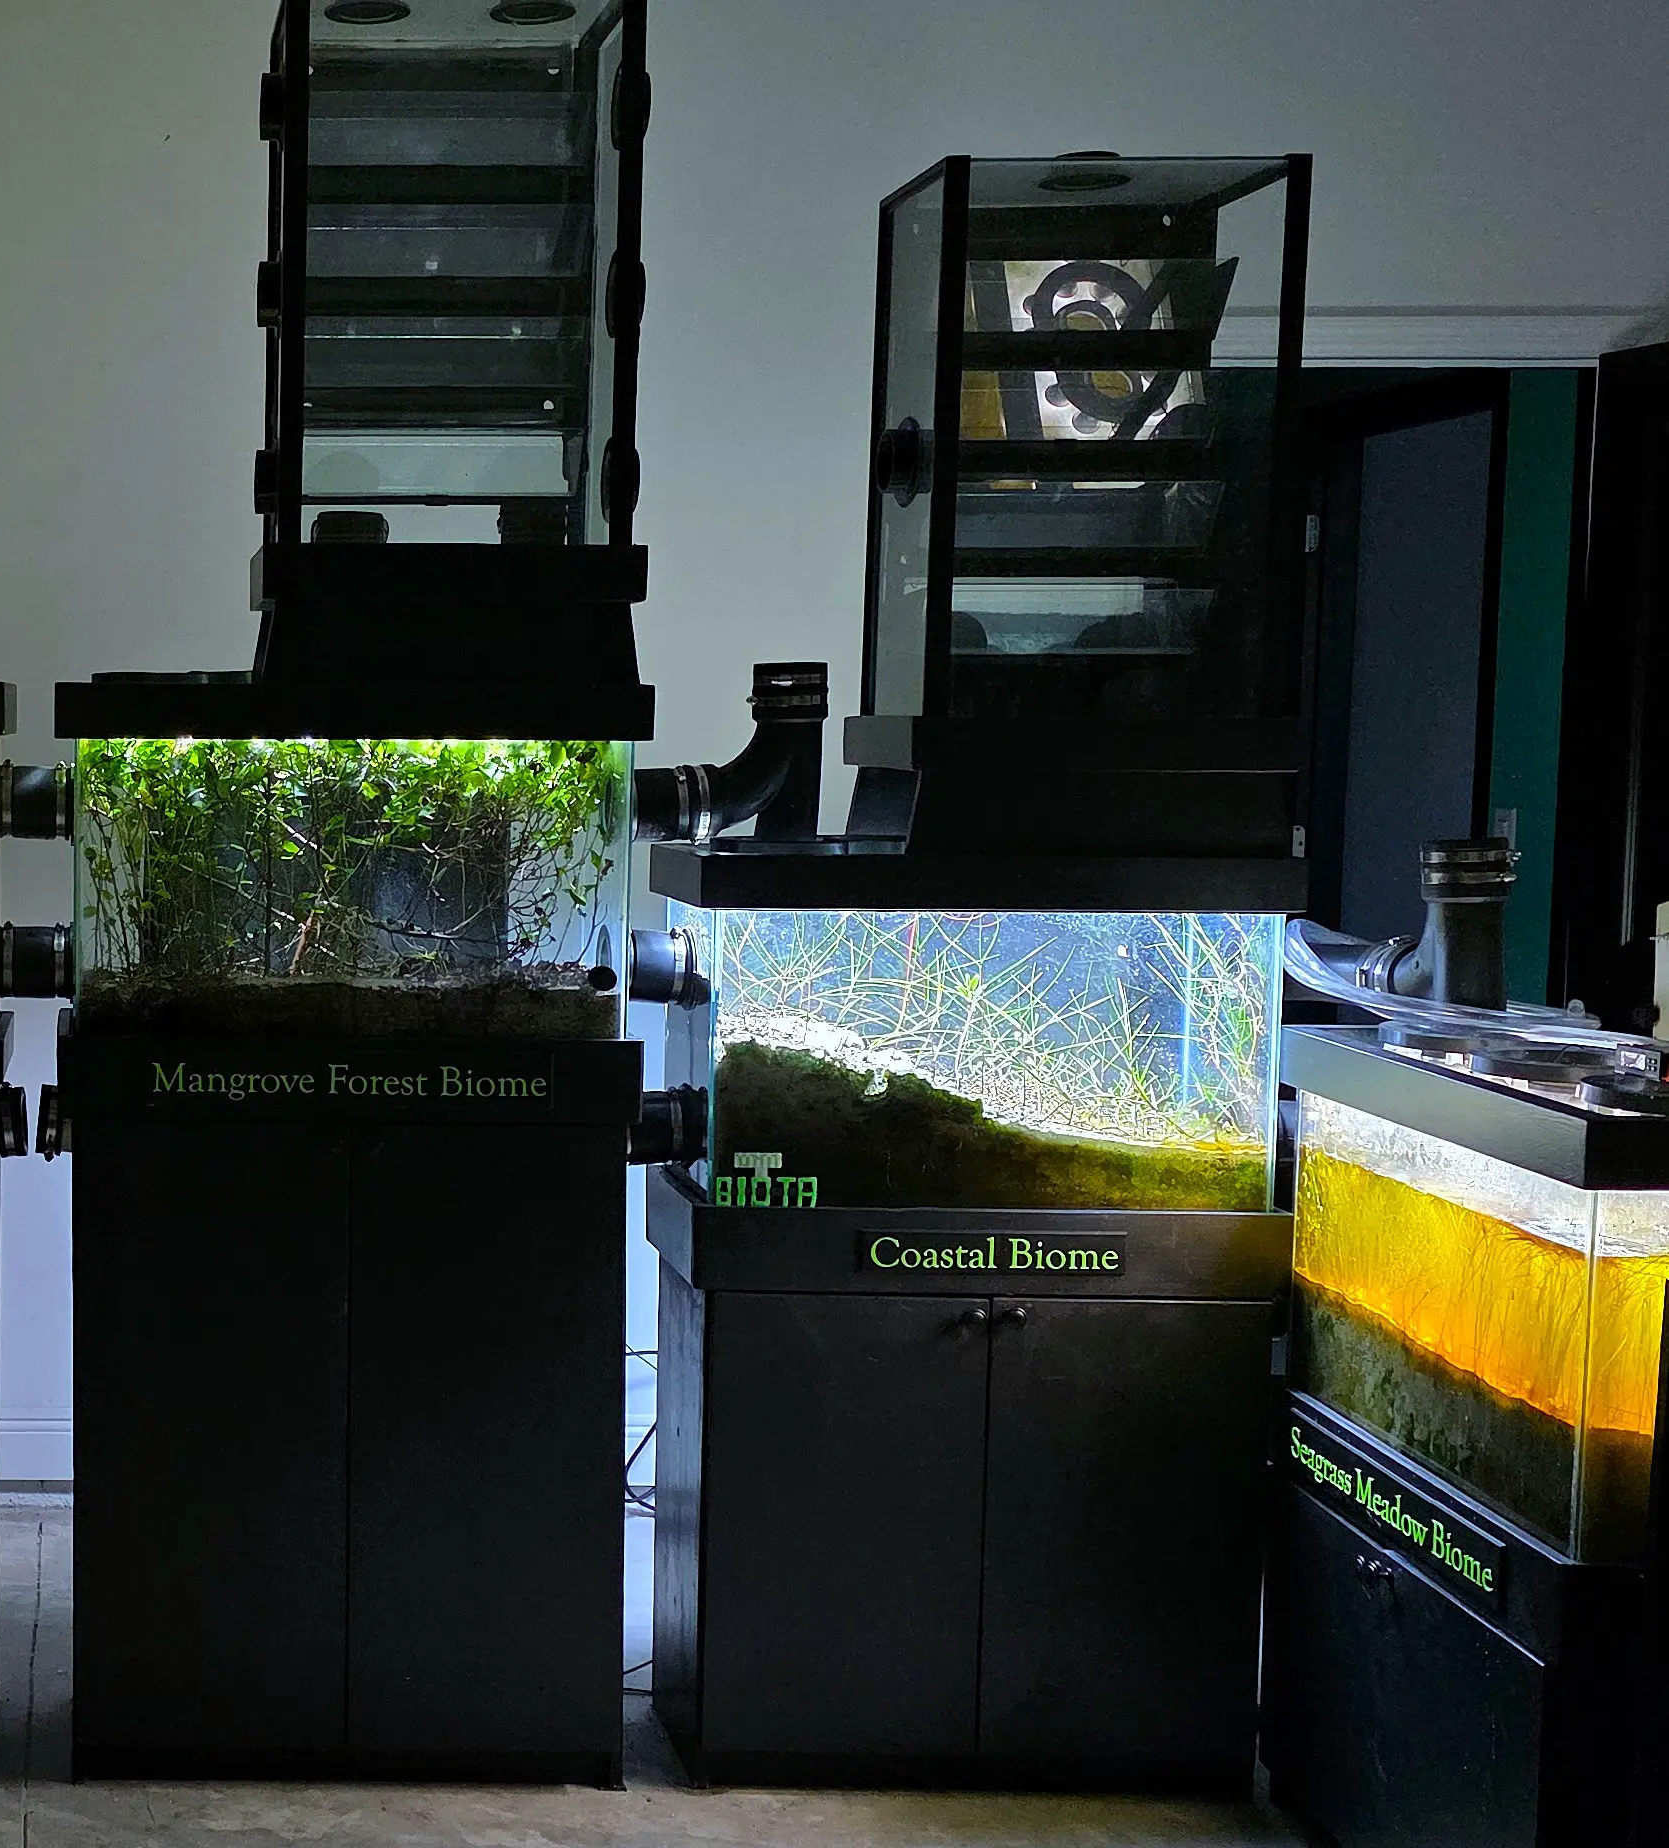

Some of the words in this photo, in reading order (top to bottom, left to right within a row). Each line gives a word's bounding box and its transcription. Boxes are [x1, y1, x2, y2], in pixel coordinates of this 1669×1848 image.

[152, 1062, 315, 1100] Mangrove
[328, 1063, 428, 1097] Forest
[439, 1065, 547, 1097] Biome
[716, 1176, 818, 1208] BIOTA
[870, 1236, 997, 1269] Coastal
[1009, 1237, 1119, 1270] Biome
[1290, 1426, 1353, 1495] Seagrass
[1353, 1468, 1429, 1547] Meadow
[1430, 1519, 1495, 1592] Biome
